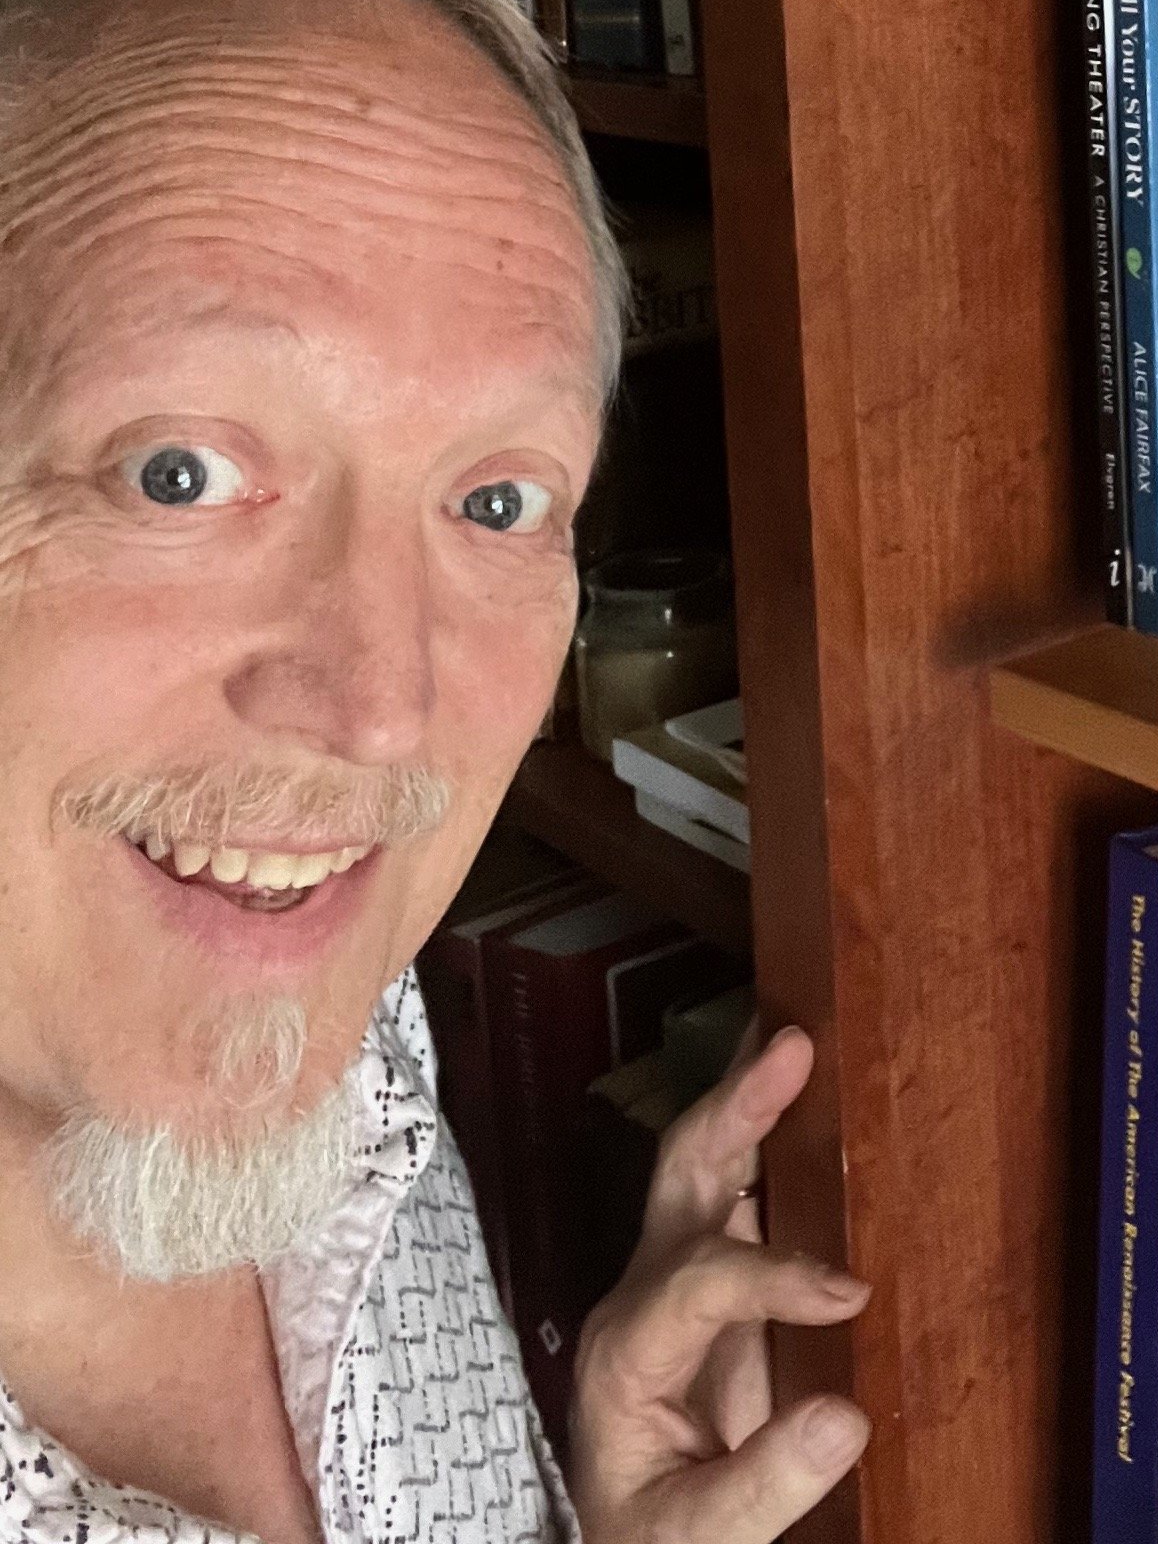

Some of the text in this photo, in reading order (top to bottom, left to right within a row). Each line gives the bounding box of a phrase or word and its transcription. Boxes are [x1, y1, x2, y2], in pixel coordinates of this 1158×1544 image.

[1087, 43, 1106, 158] THEATER
[1120, 22, 1140, 92] Your
[1123, 96, 1145, 207] STORY
[1093, 175, 1114, 415] A CHRISTIAN PERSPECTIVE
[1132, 341, 1152, 494] ALICE FAIRFAX
[1118, 894, 1146, 1464] The History of The American Renaissance Festival
